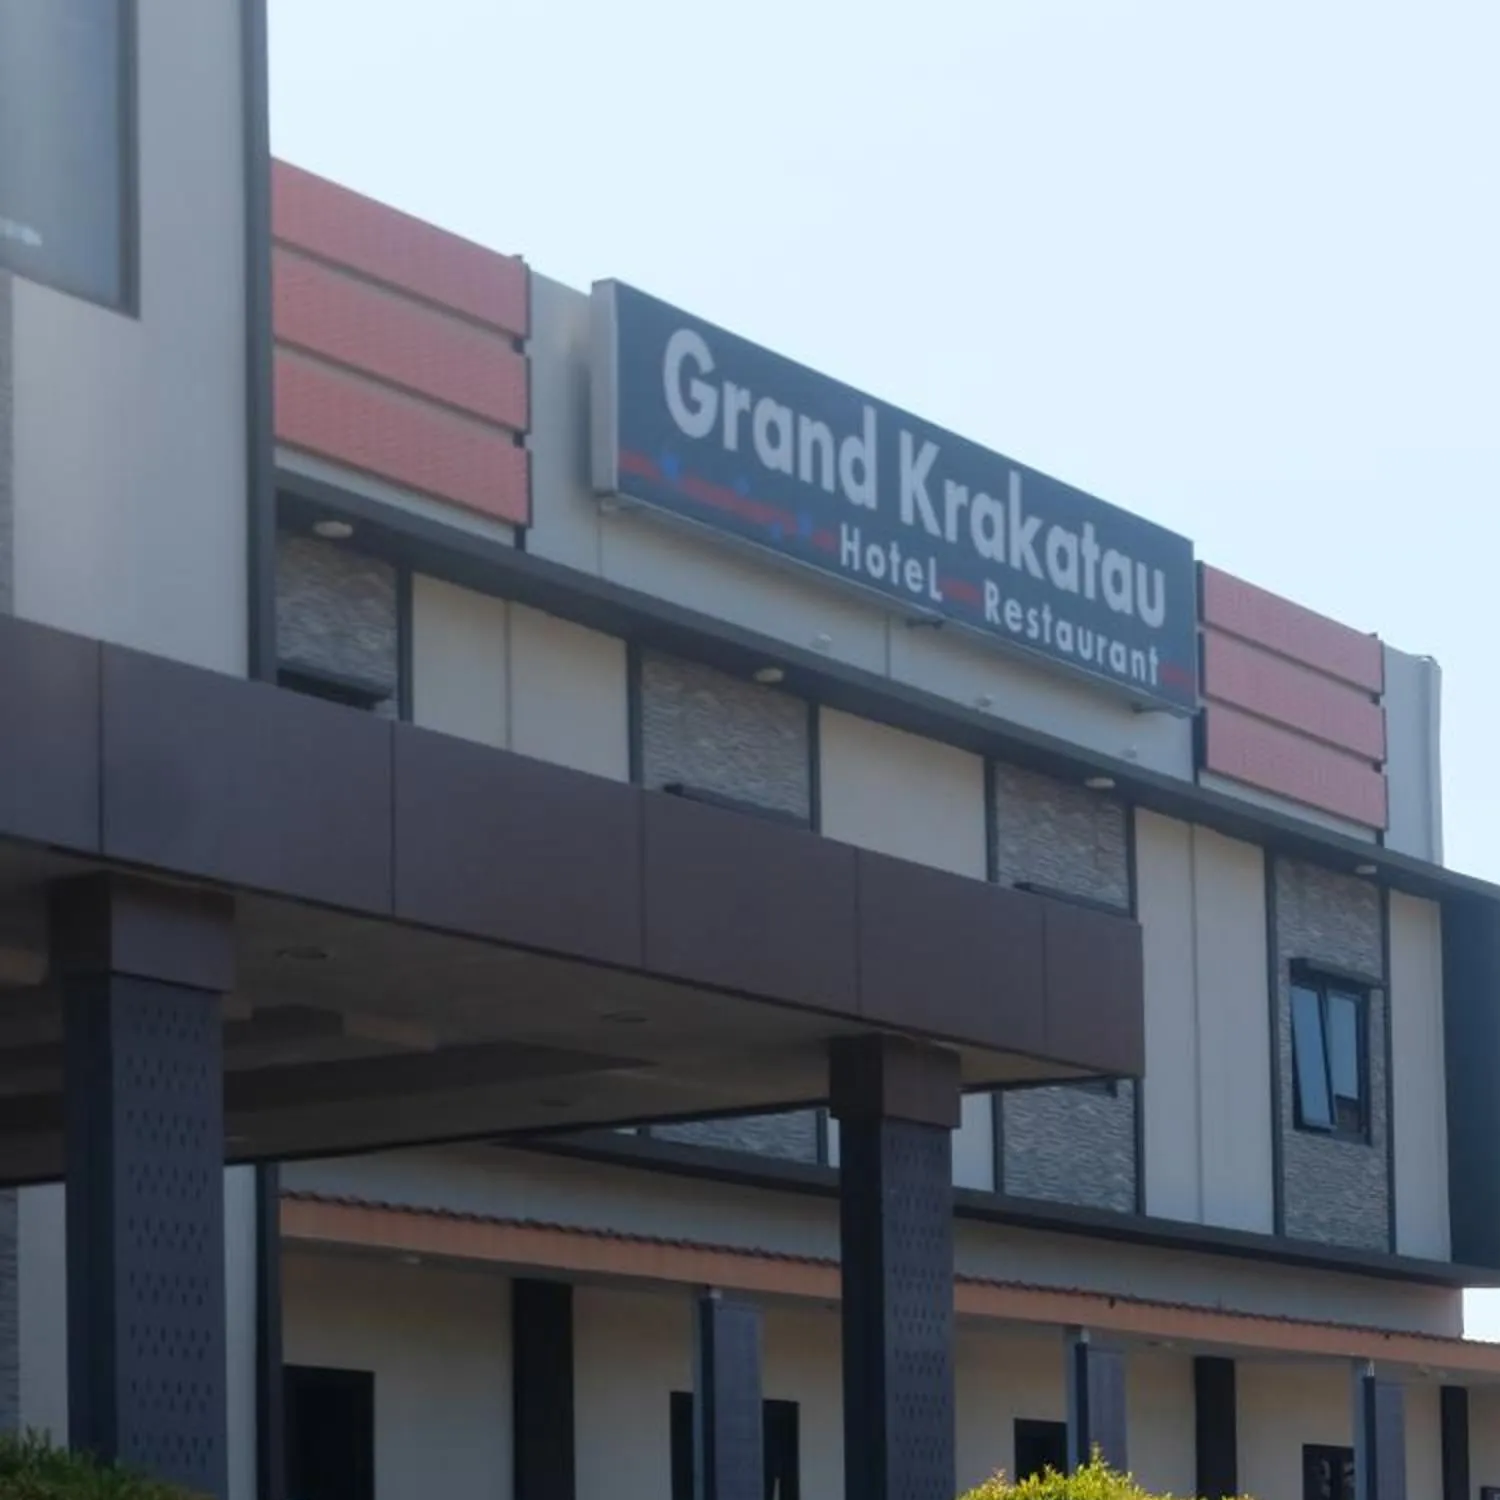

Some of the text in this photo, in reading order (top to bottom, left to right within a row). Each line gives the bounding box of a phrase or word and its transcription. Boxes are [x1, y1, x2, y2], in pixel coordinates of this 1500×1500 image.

[663, 328, 1166, 628] Grand Krakatau
[985, 580, 1160, 686] Restaurant
